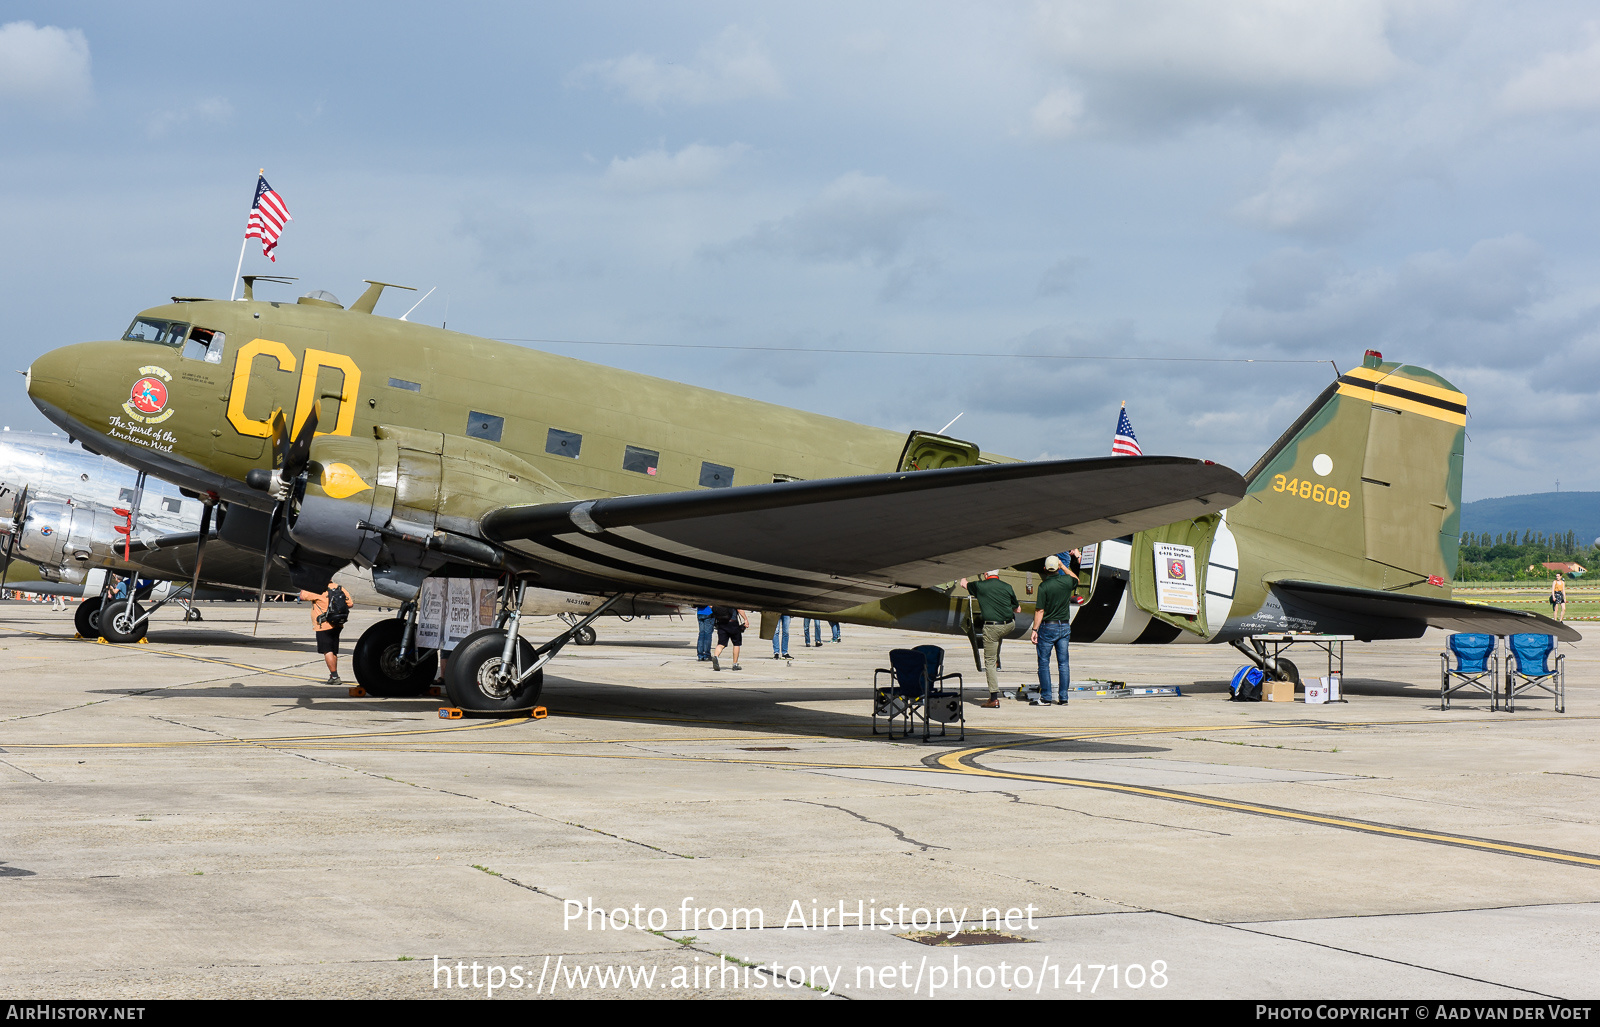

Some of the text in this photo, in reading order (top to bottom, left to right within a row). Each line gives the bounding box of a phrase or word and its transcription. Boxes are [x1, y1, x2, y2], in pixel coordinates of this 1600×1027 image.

[225, 338, 361, 443] CD
[106, 427, 173, 453] American West
[109, 416, 178, 443] The Spirit of the
[1273, 473, 1351, 509] 348608
[451, 607, 470, 622] CENTER
[566, 598, 591, 606] N431HM
